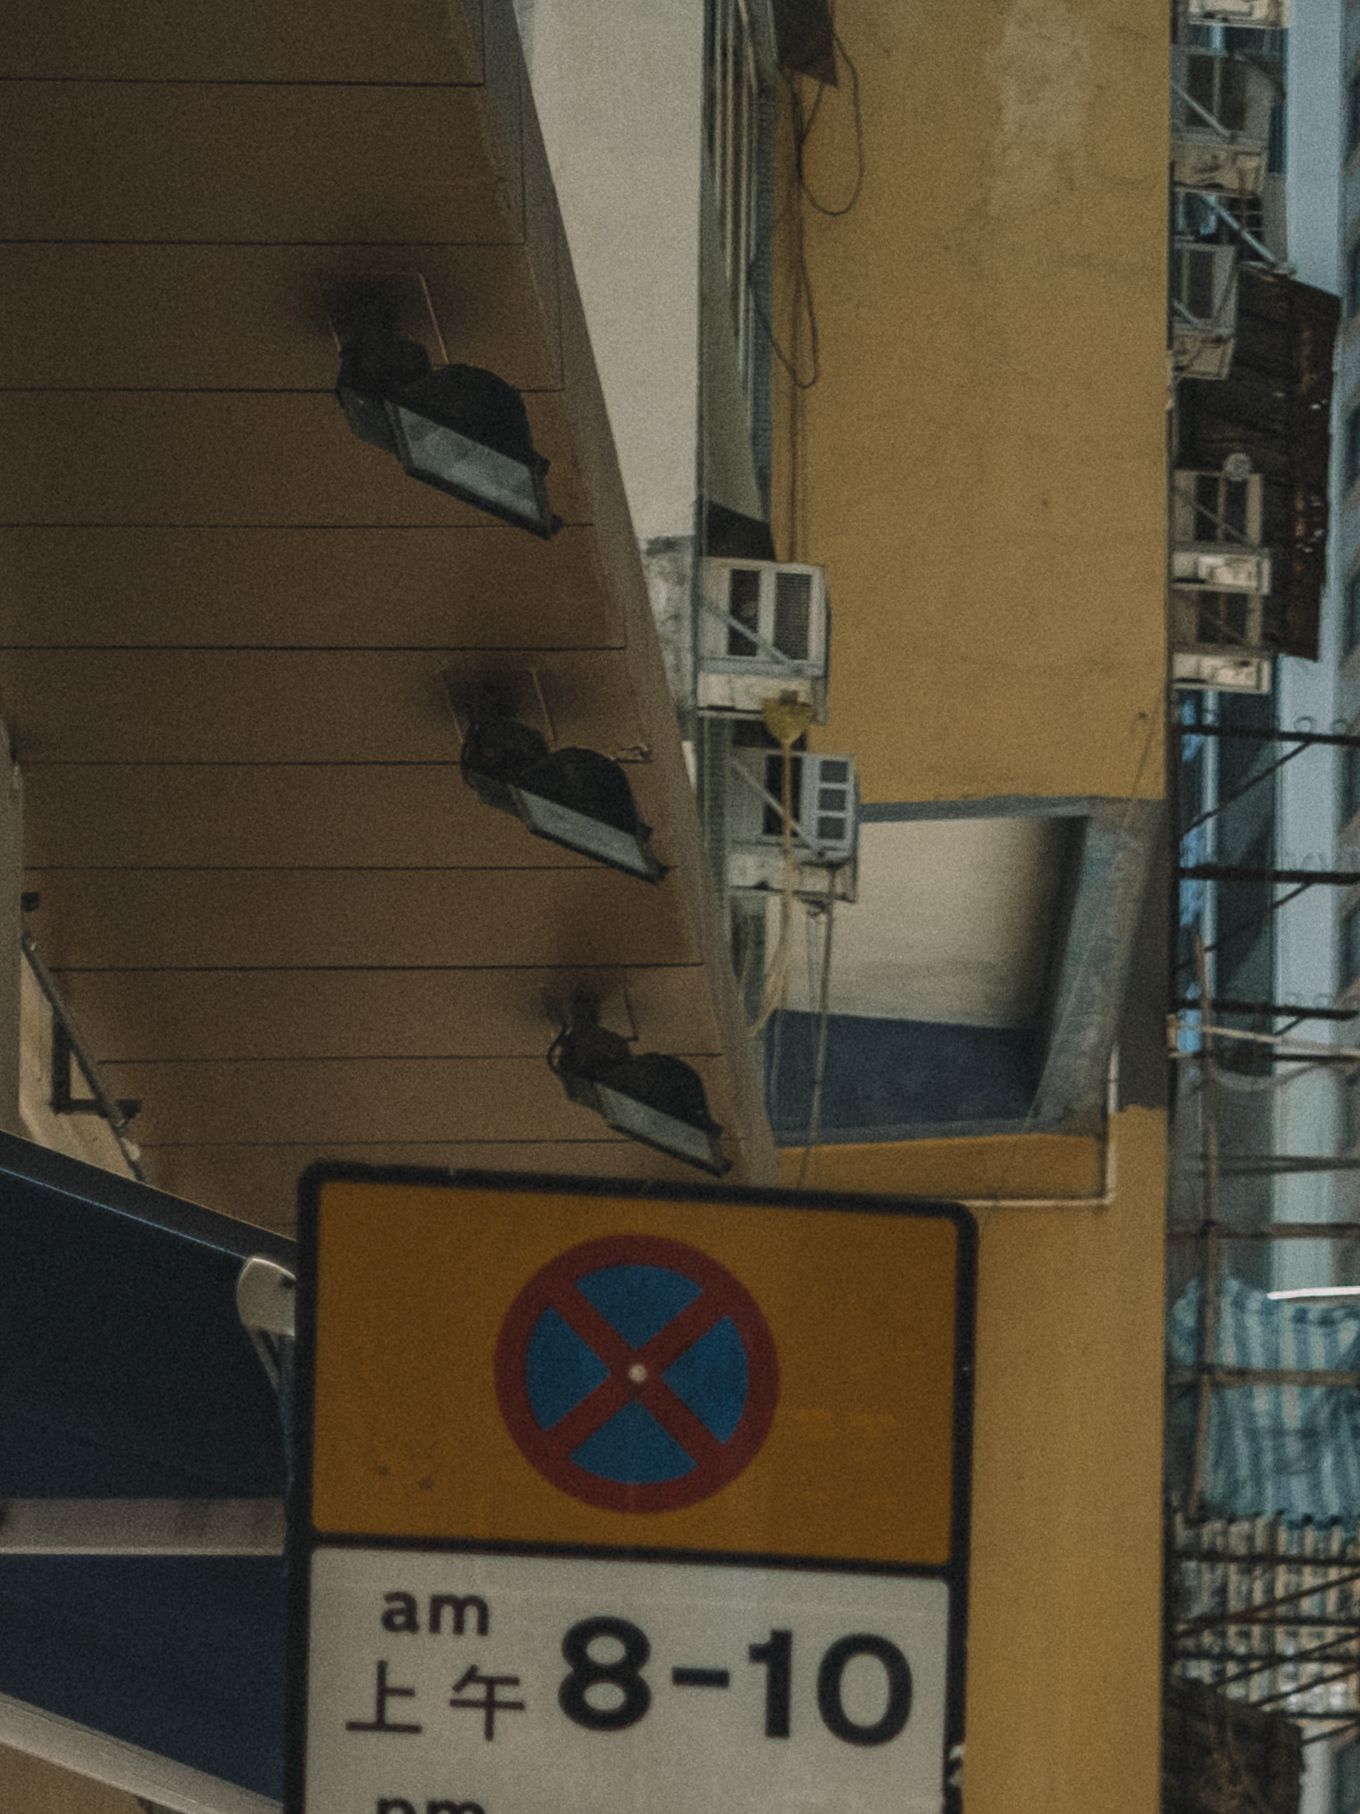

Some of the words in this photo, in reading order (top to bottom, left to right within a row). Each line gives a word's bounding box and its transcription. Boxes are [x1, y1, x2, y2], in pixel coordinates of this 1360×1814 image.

[380, 1591, 491, 1637] am
[345, 1659, 525, 1742] 上午
[558, 1615, 914, 1748] 8-10
